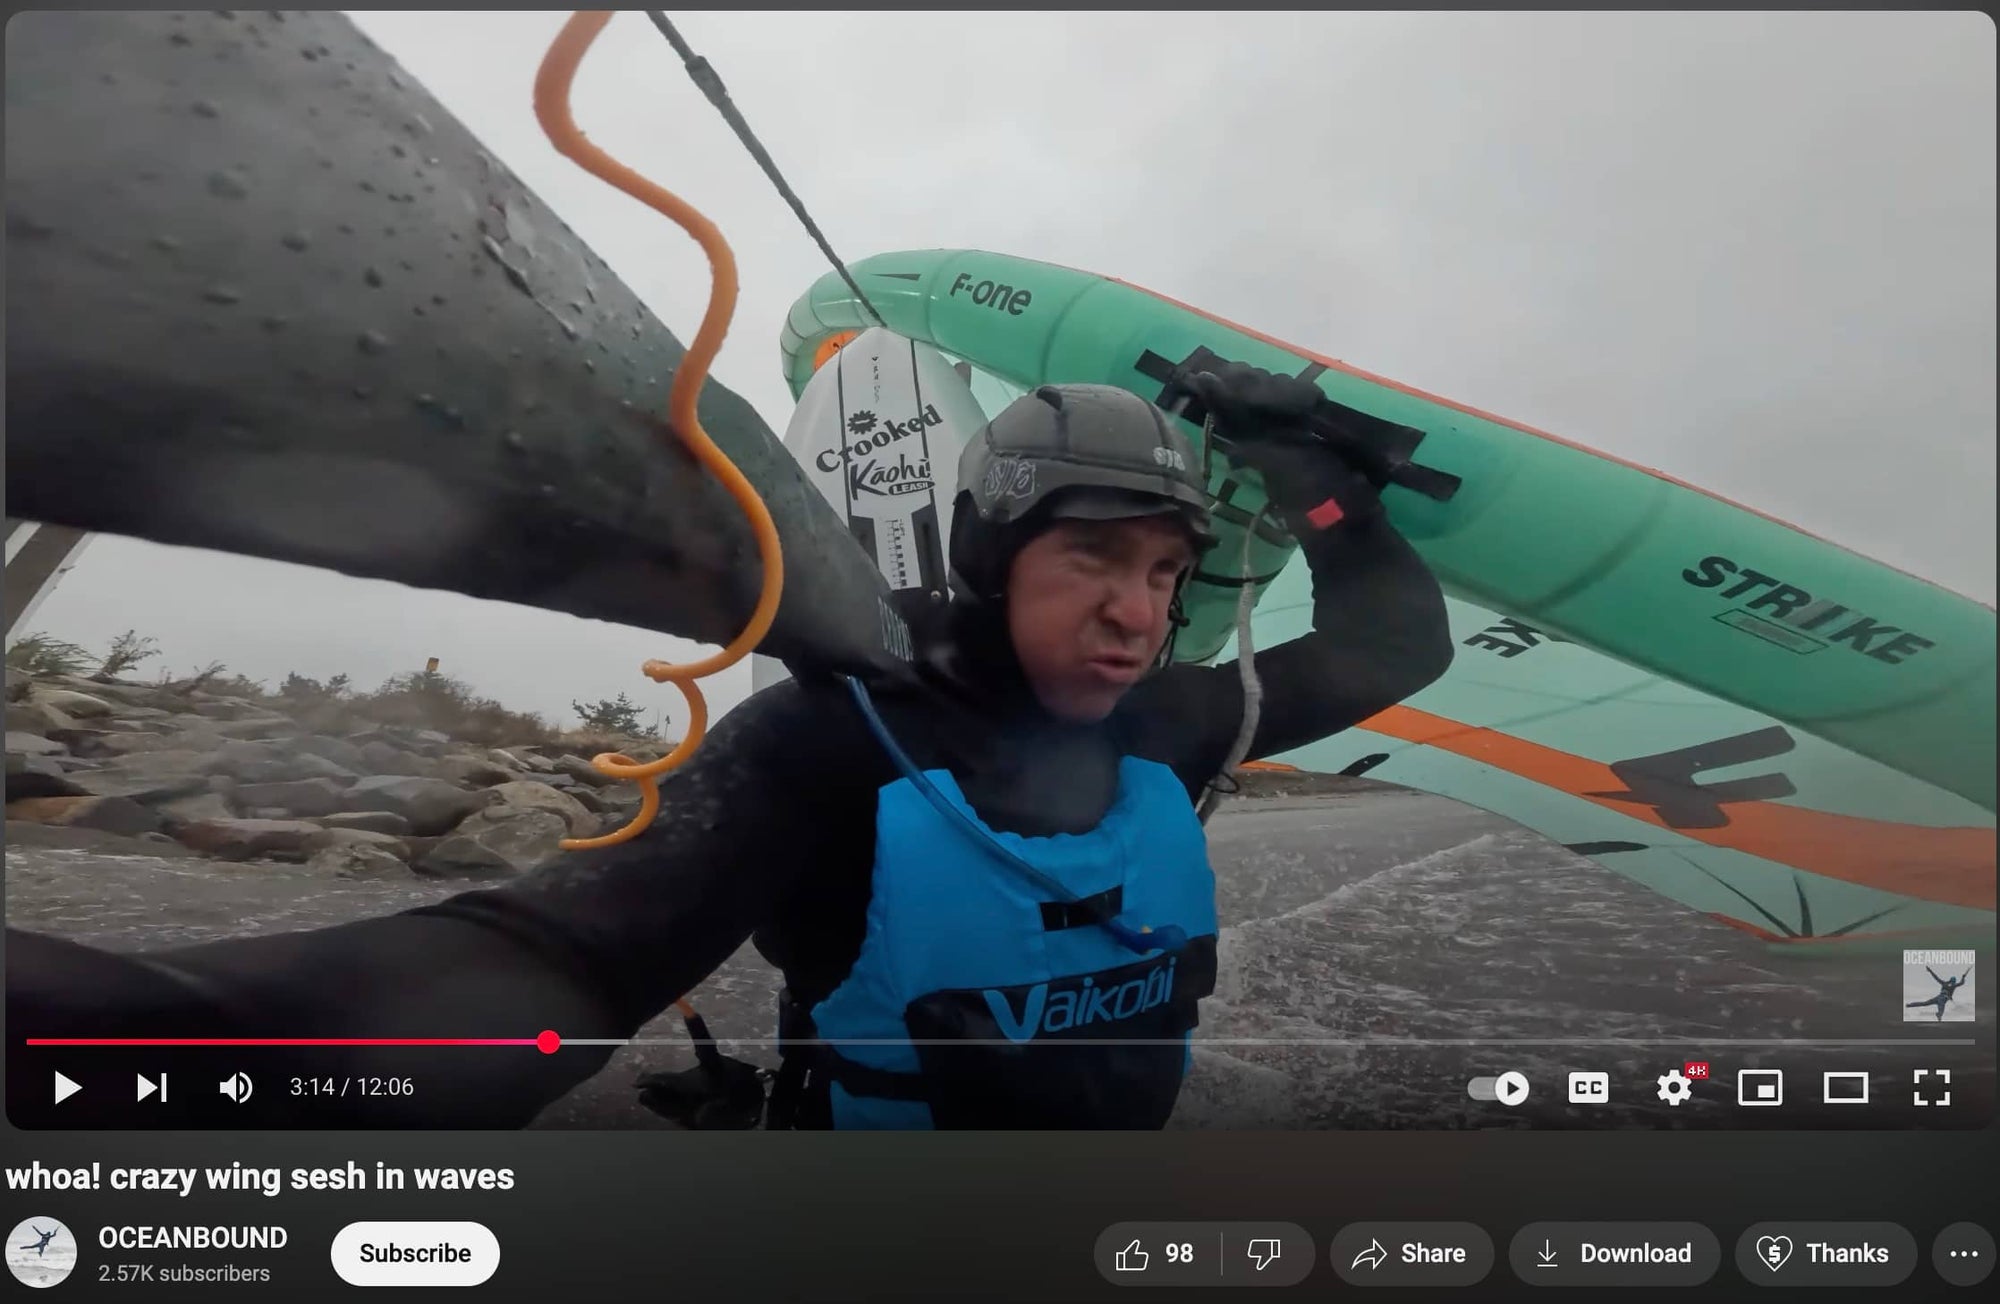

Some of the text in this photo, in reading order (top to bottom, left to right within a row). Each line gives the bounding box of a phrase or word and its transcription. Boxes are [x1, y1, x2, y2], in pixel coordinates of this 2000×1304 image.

[815, 403, 943, 473] Crooked
[1682, 556, 1936, 665] STRIKE
[982, 956, 1177, 1044] Vaikobi
